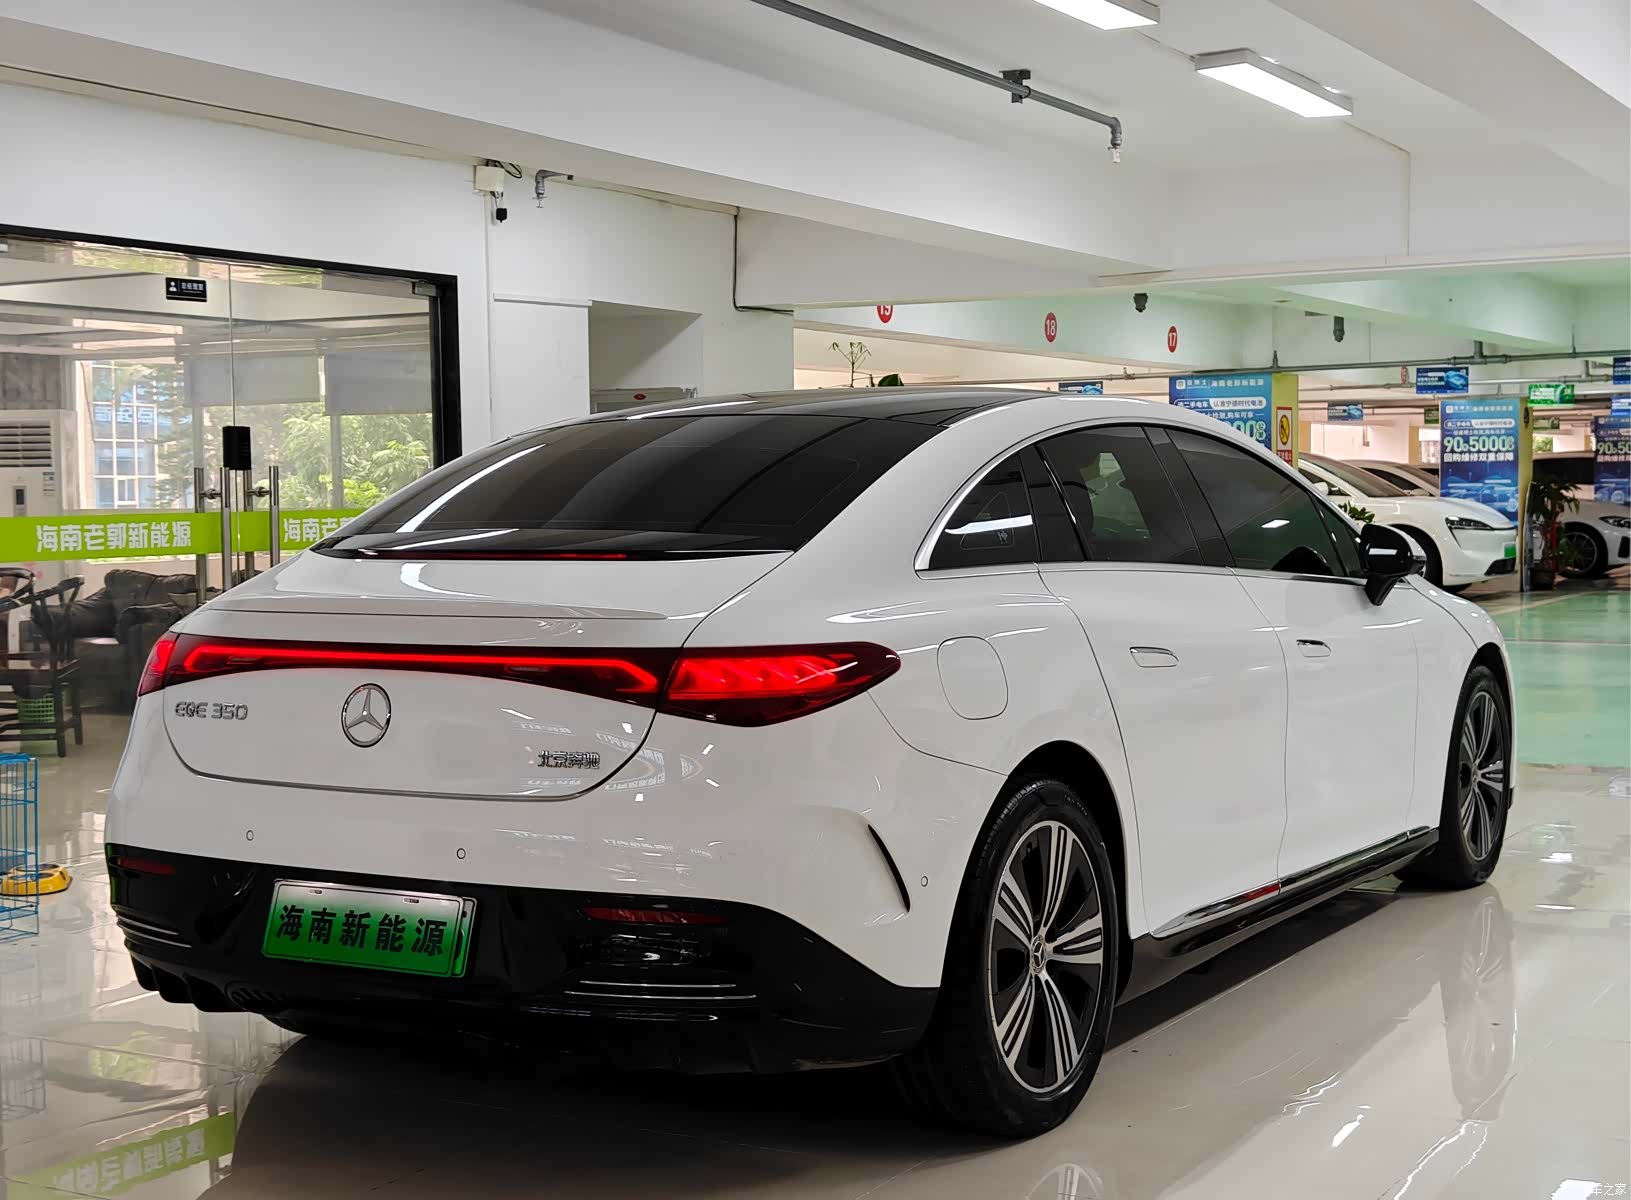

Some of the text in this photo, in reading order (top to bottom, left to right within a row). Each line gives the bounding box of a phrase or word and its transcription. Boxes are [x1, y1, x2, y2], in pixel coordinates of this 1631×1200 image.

[1046, 319, 1056, 336] 18
[1169, 332, 1176, 346] 17
[36, 521, 192, 552] 海南老郭新能源
[175, 701, 249, 720] EQE 350
[538, 750, 600, 769] 北京奔驰
[276, 904, 447, 957] 海南新能源
